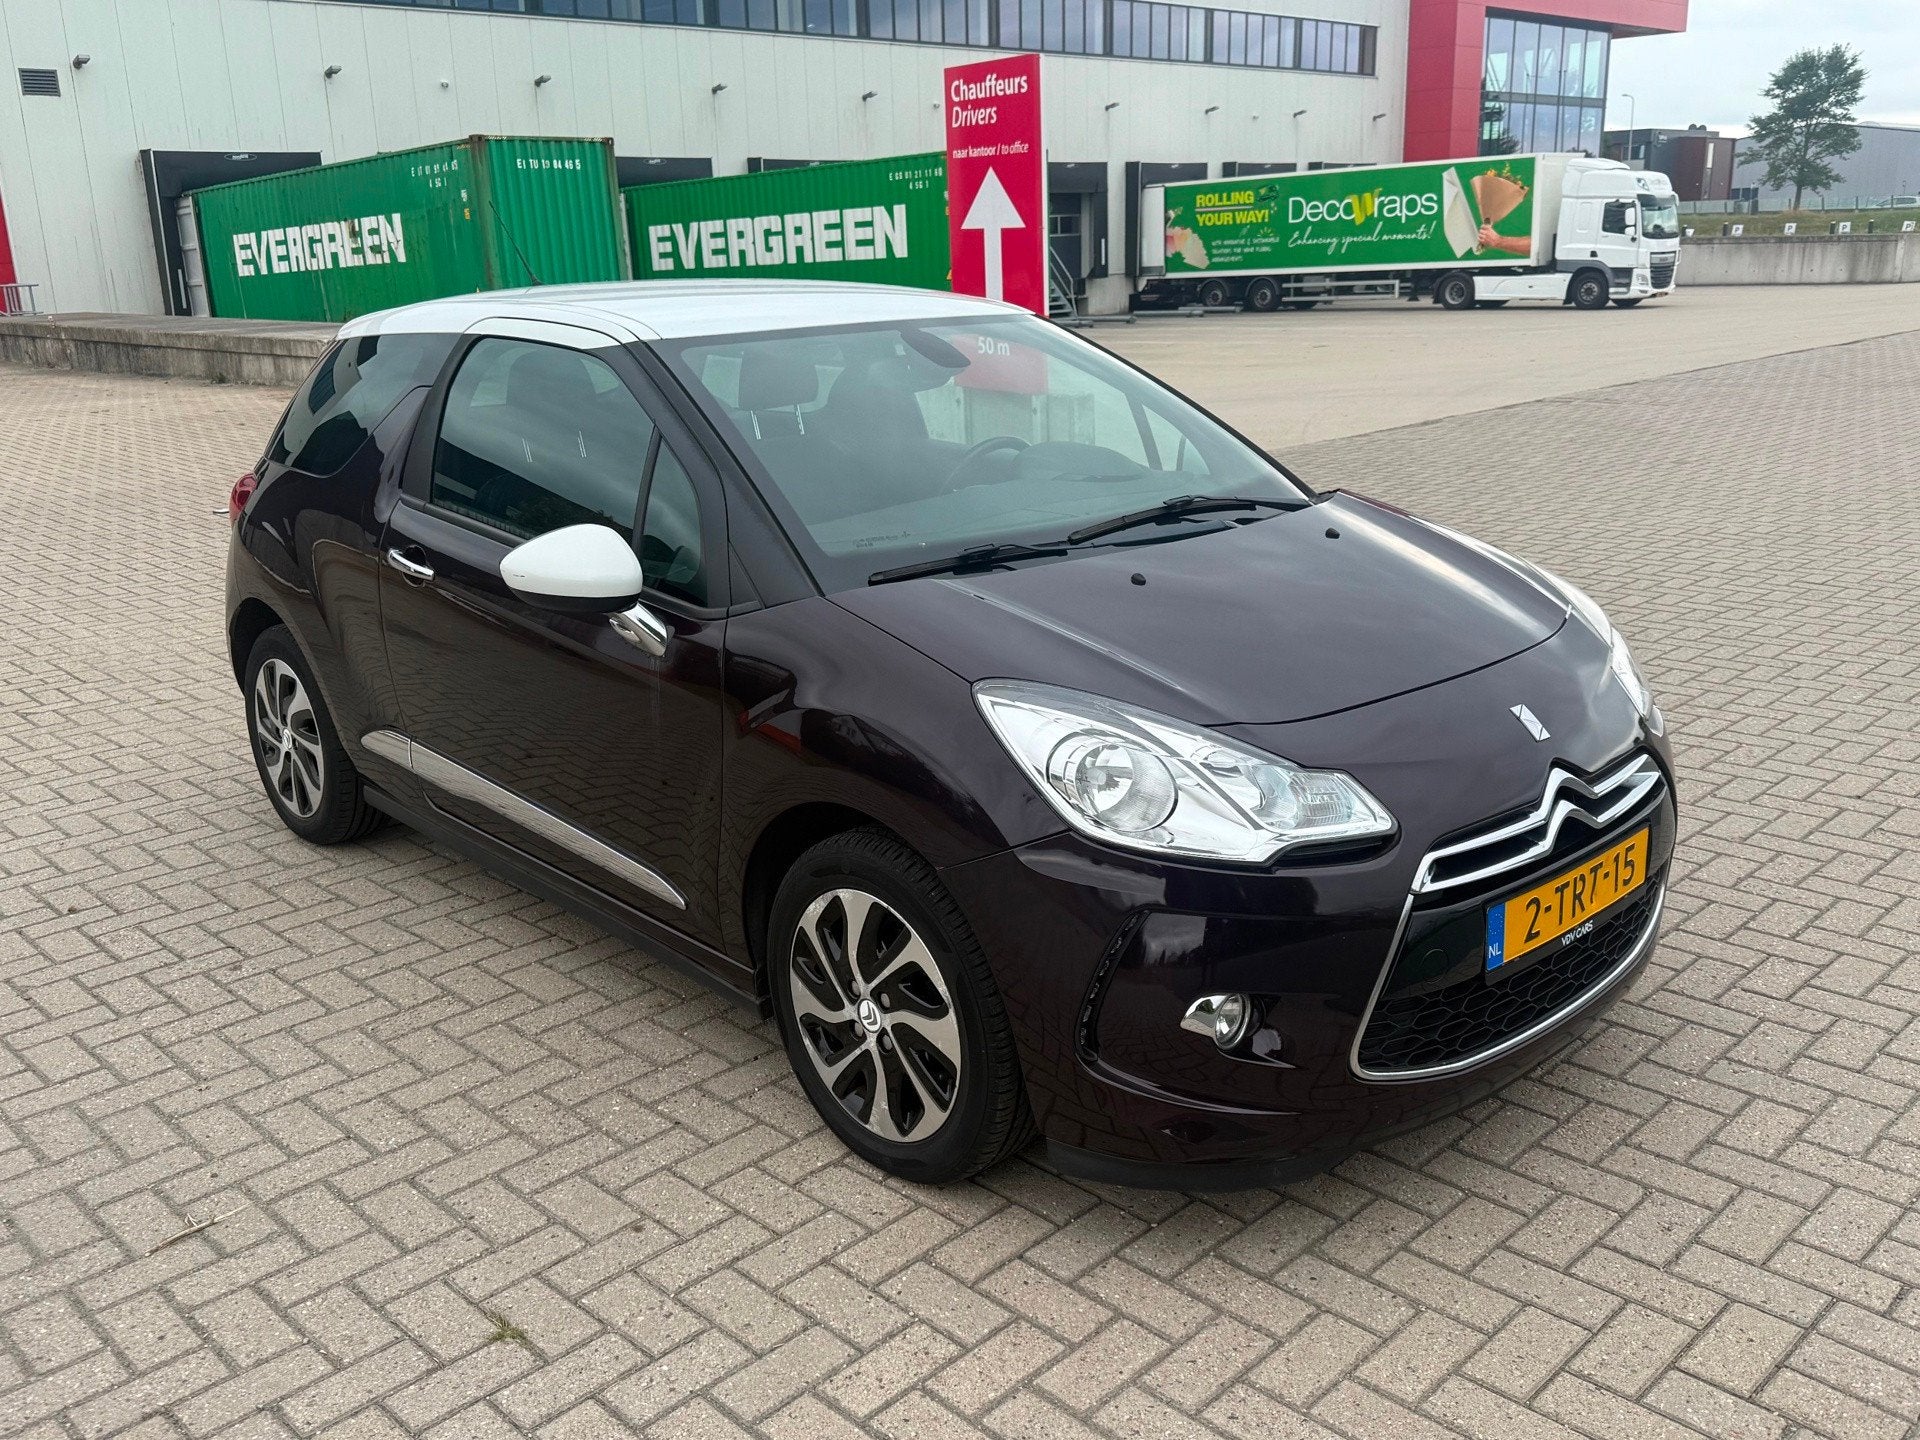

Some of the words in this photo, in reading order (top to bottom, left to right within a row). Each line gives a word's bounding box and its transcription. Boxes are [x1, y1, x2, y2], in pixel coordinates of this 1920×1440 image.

[951, 73, 1028, 102] Chauffeurs
[952, 104, 997, 128] Drivers
[953, 149, 968, 158] naar
[969, 146, 996, 157] kantoor
[1001, 144, 1009, 154] to
[1010, 140, 1029, 153] office
[1195, 190, 1255, 208] ROLLING
[1288, 188, 1439, 226] DecoWraps
[1195, 211, 1233, 227] YOUR
[1234, 209, 1270, 224] WAY!
[233, 213, 407, 277] EVERGREEN
[648, 204, 908, 271] EVERGREEN
[1288, 225, 1339, 255] Enhancing
[1341, 221, 1384, 254] special
[1381, 220, 1437, 241] moments!
[978, 336, 994, 355] 50
[997, 342, 1010, 356] m
[1523, 842, 1636, 944] 2-TRT-15
[1488, 943, 1501, 959] NL
